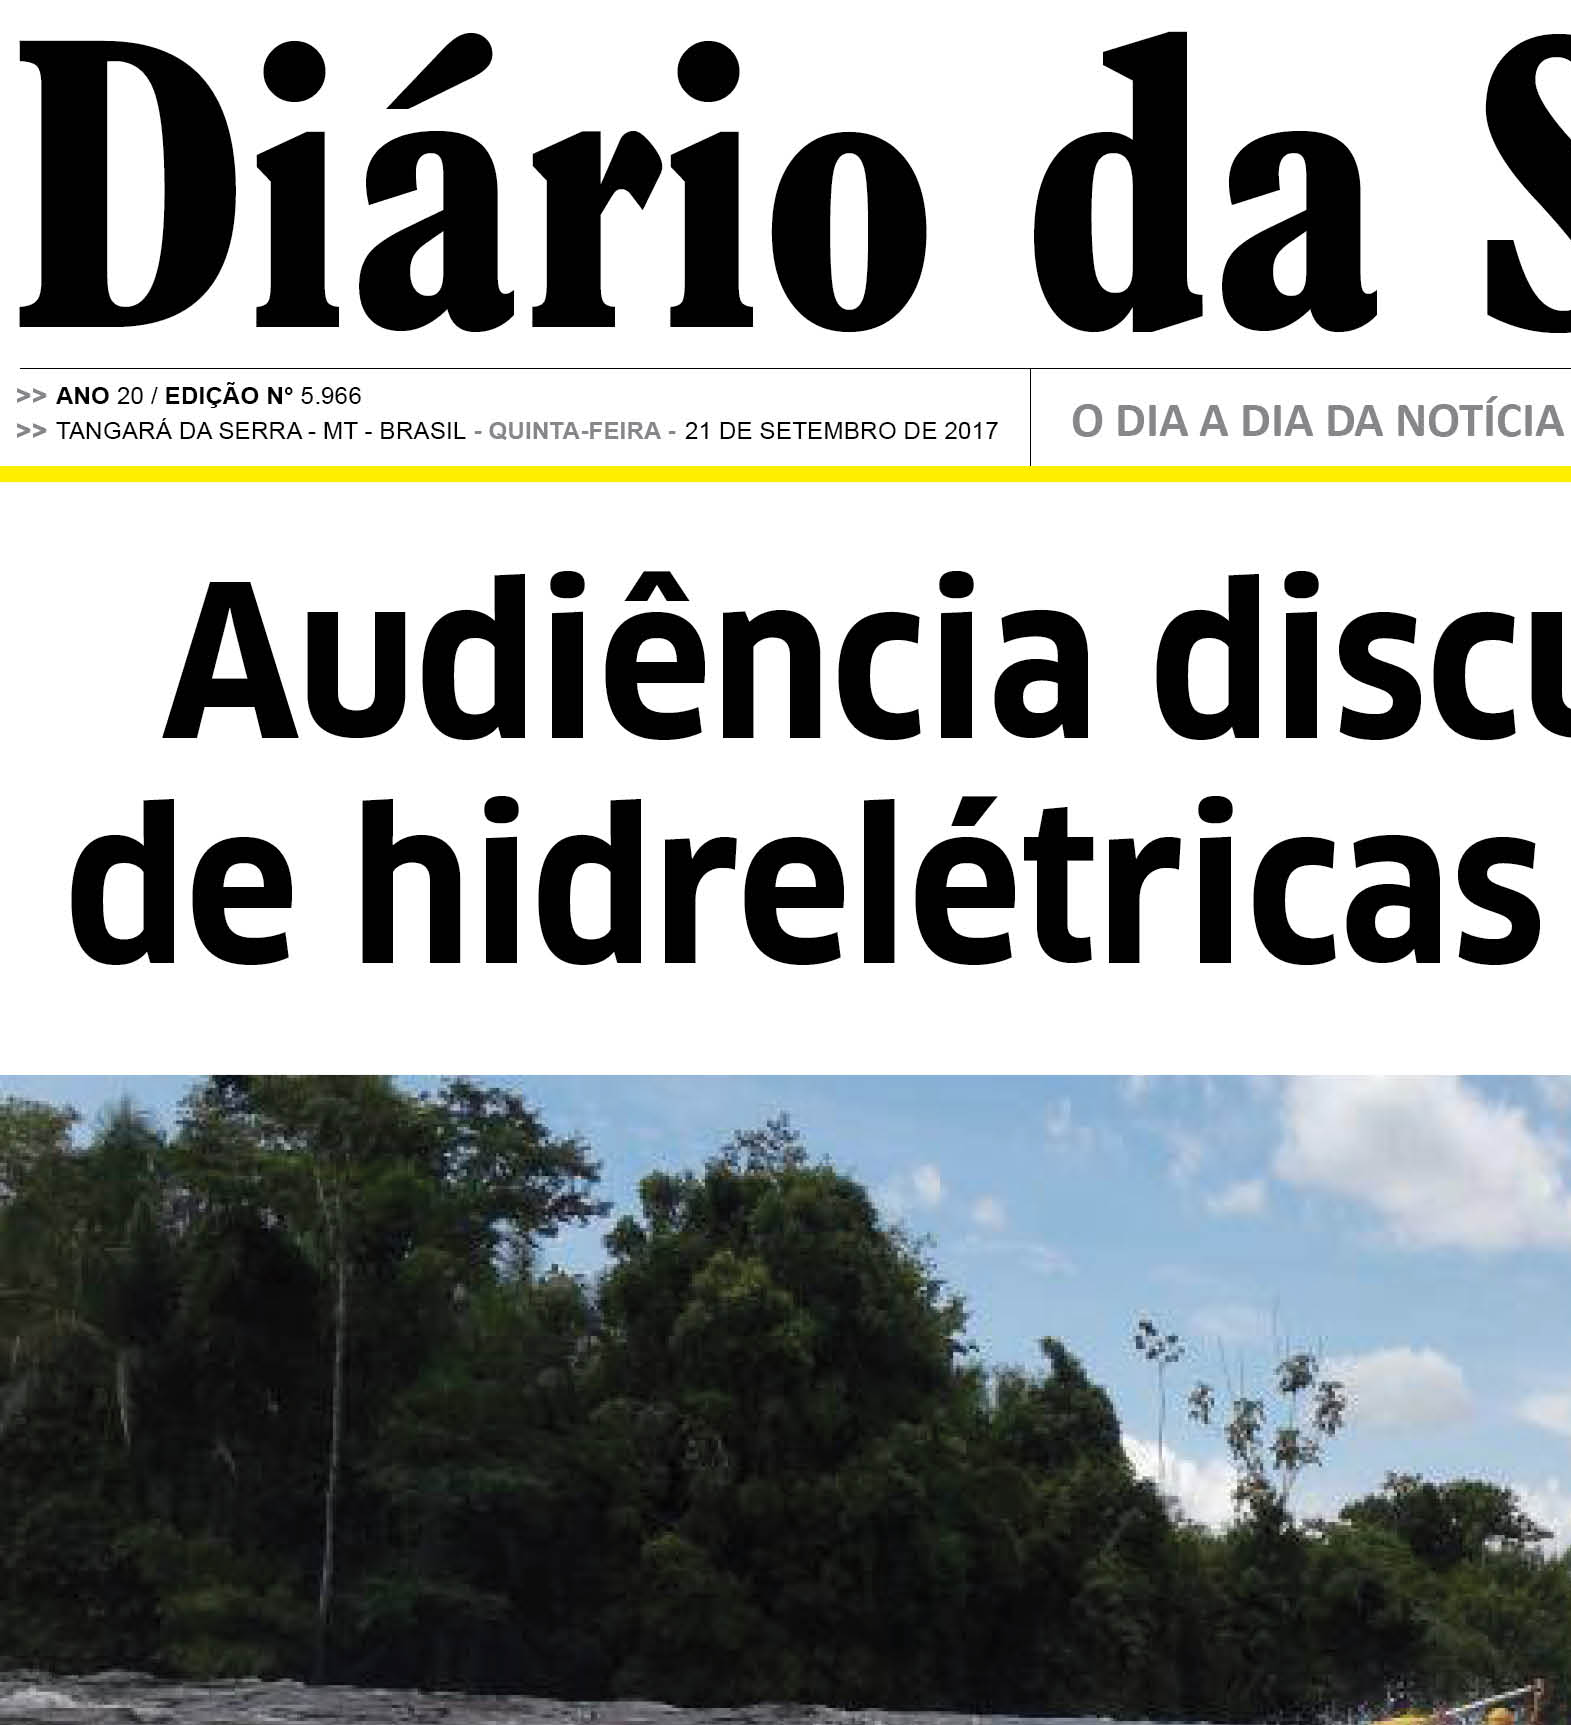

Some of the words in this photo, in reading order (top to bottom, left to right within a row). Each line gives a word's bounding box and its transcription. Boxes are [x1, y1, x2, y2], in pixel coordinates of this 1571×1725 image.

[18, 32, 928, 333] Diário
[1033, 31, 1378, 333] da
[55, 386, 110, 405] ANO
[116, 386, 144, 405] 20
[165, 381, 259, 409] EDIÇÃO
[300, 386, 362, 405] 5.966
[161, 570, 1089, 741] Audiência
[70, 798, 293, 966] de
[361, 795, 1541, 966] hidrelétricas
